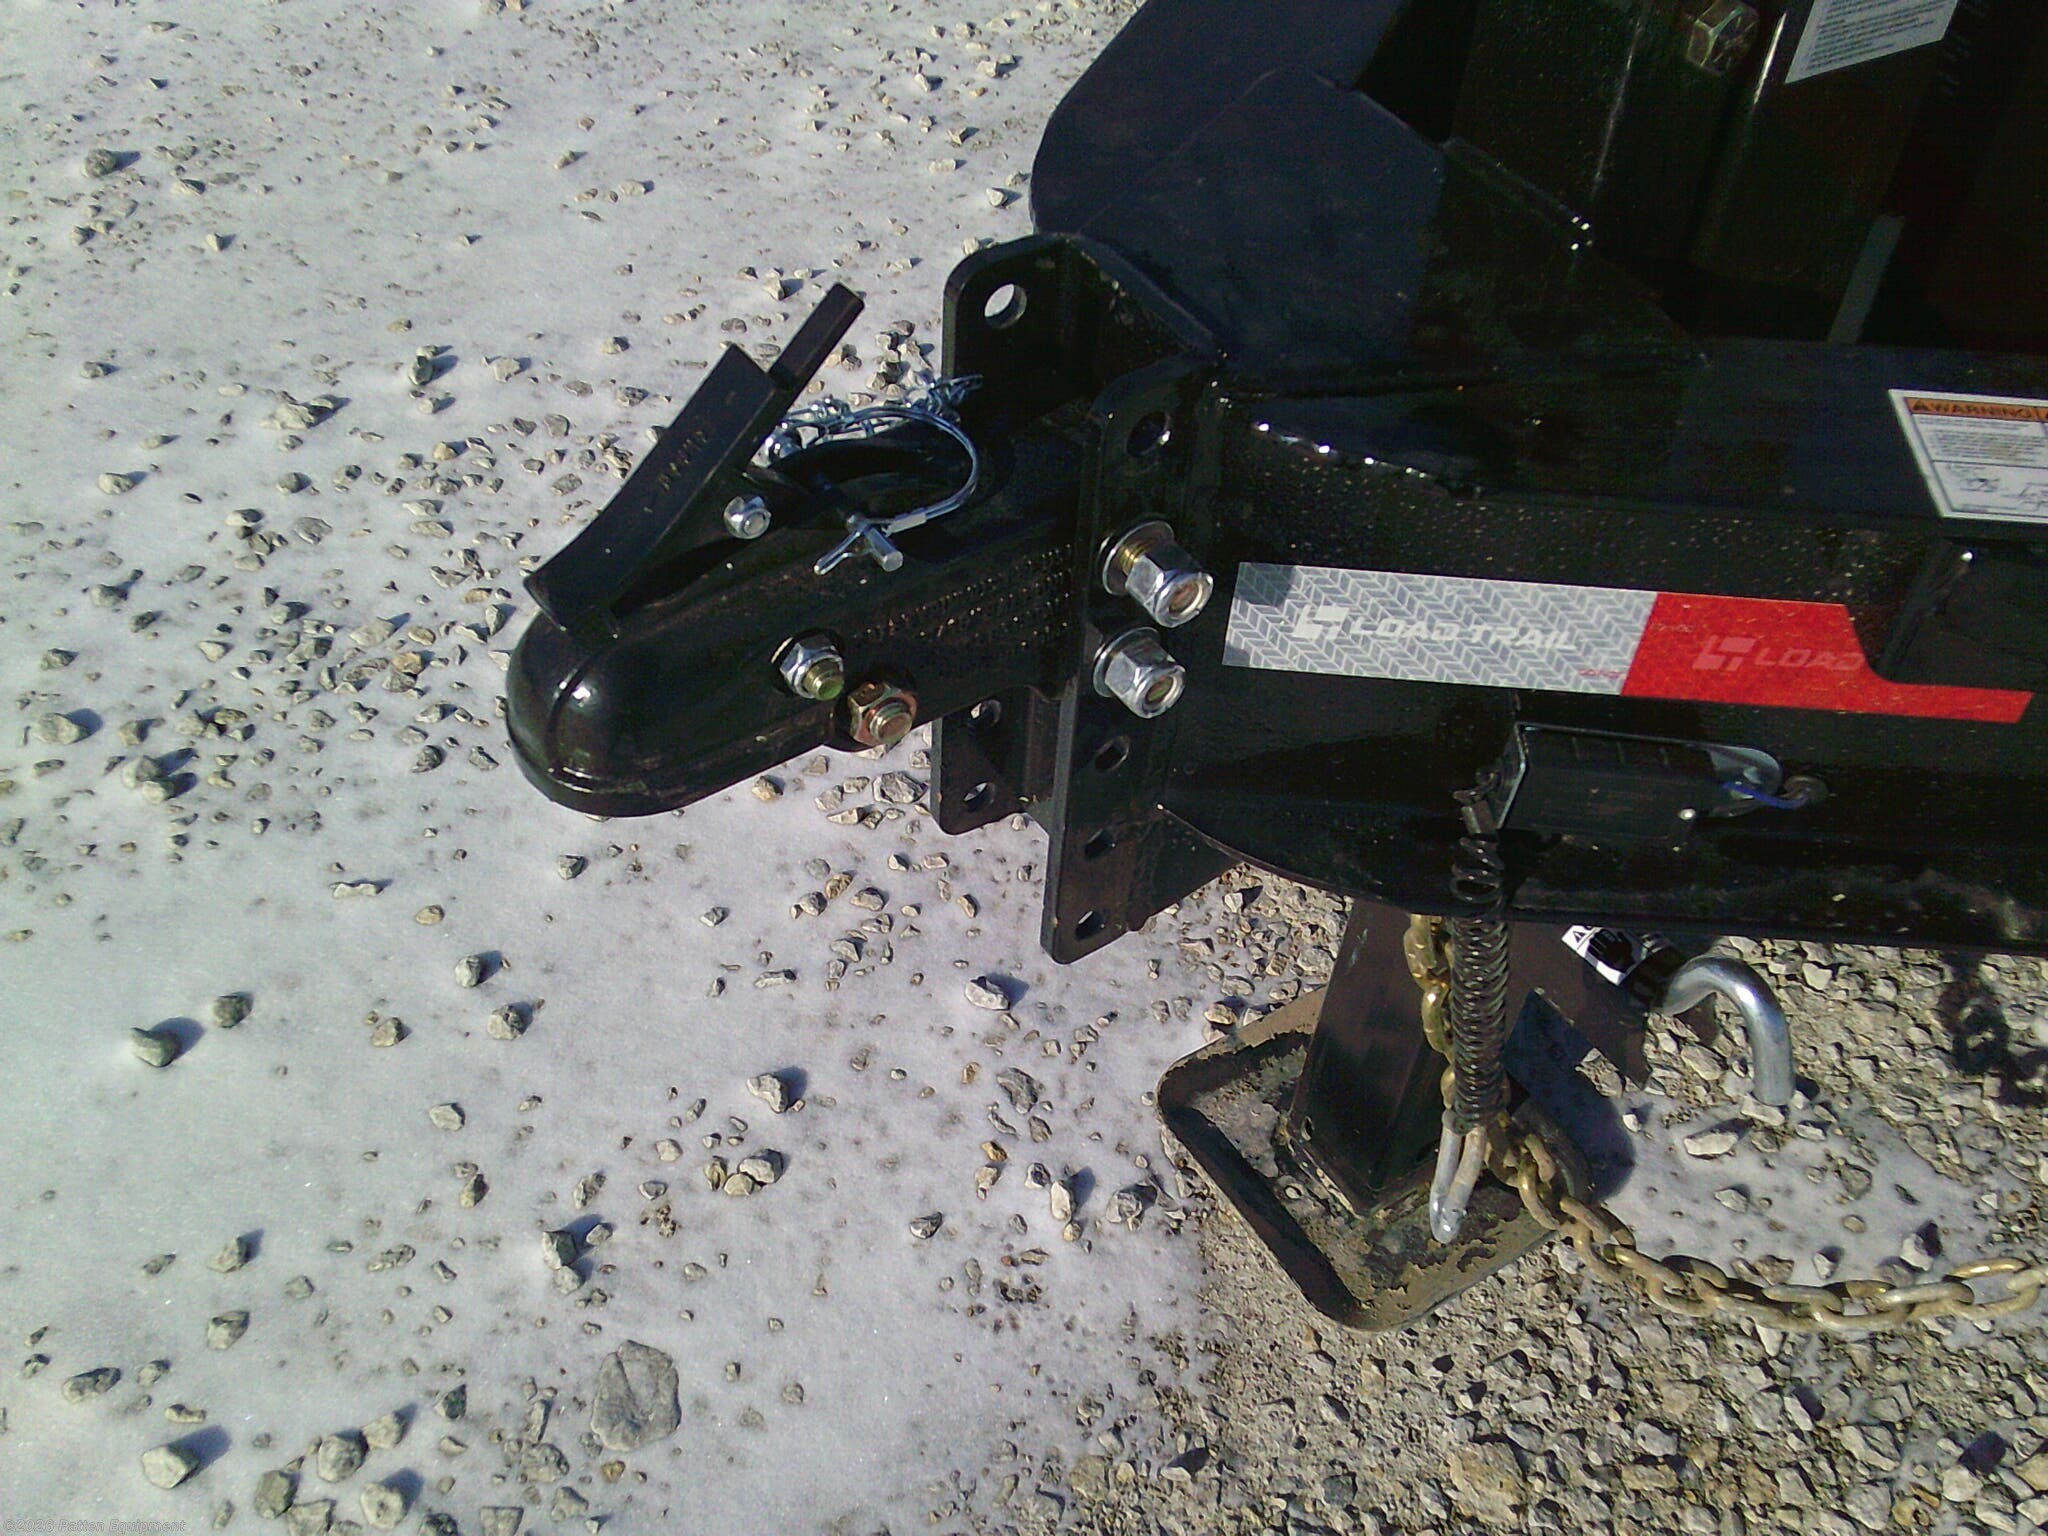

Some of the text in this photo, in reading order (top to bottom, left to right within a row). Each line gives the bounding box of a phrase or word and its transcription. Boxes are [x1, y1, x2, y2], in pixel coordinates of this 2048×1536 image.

[1350, 615, 1460, 640] LOAD
[1468, 623, 1577, 649] TRAIL
[1754, 647, 1866, 671] LOAD
